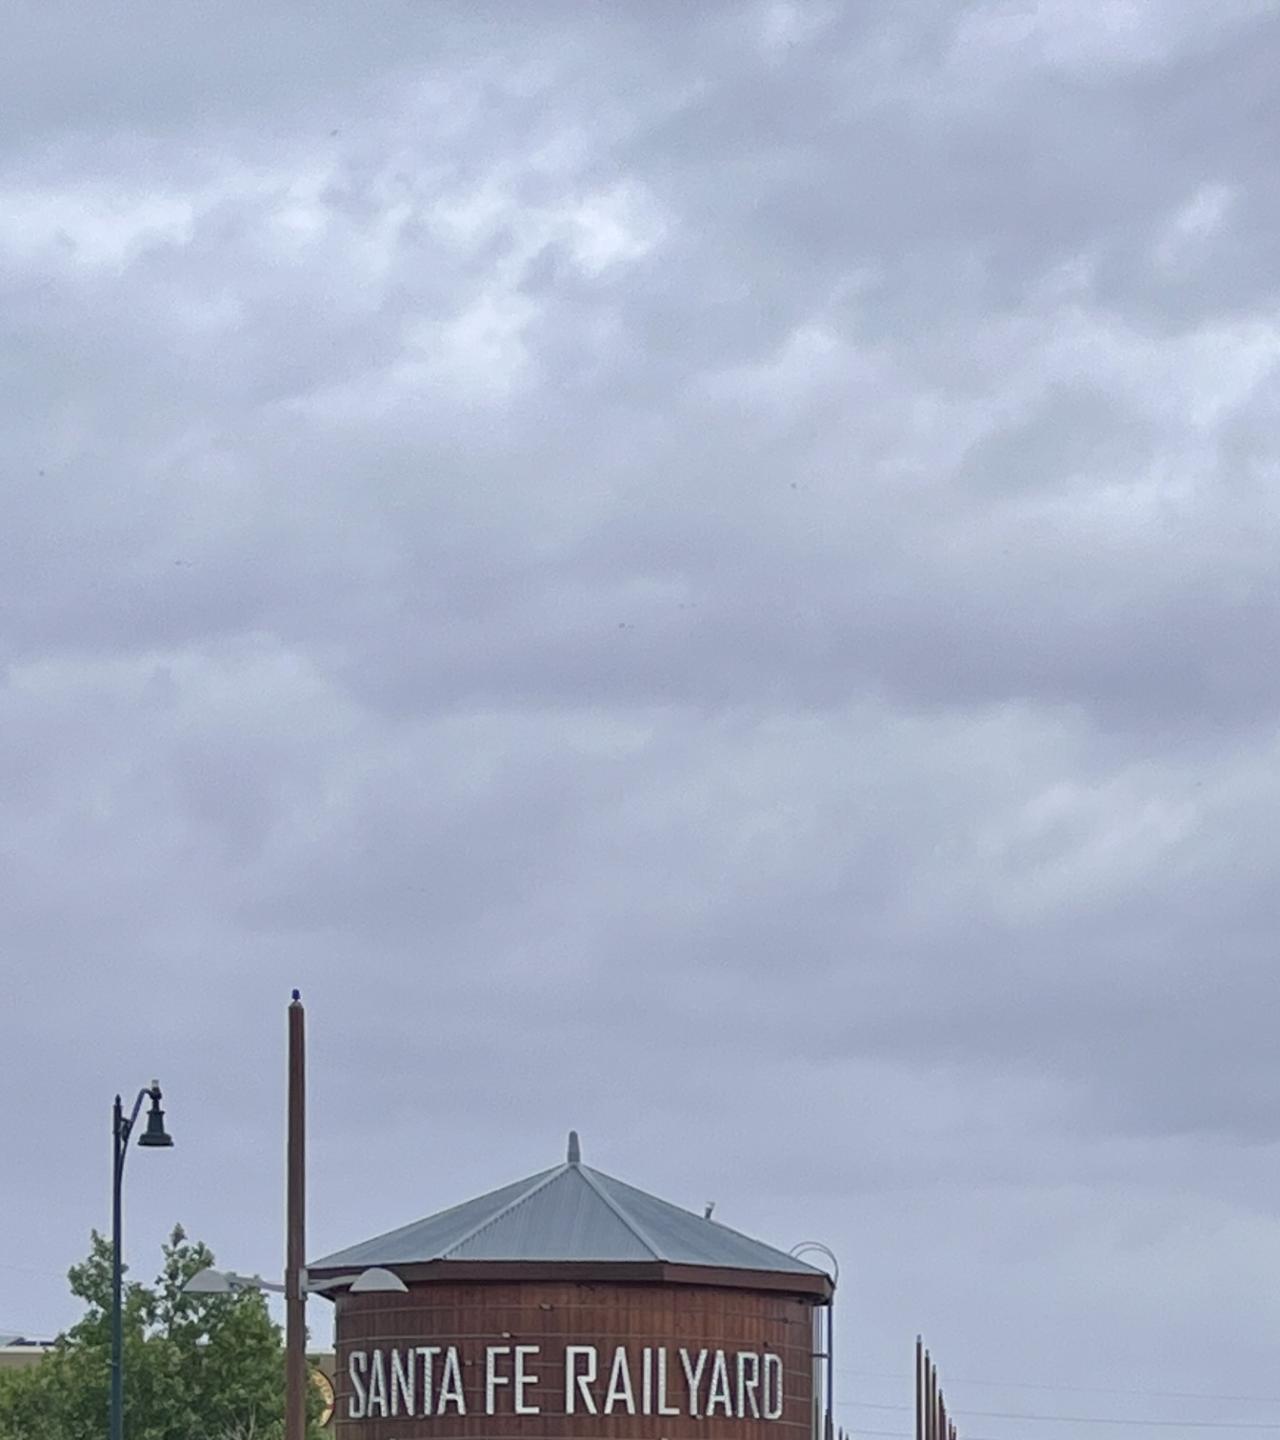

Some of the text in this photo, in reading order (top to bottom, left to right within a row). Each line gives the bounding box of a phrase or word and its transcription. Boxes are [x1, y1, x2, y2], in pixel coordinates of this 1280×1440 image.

[348, 1345, 784, 1420] SANTA FE RAILYARD
